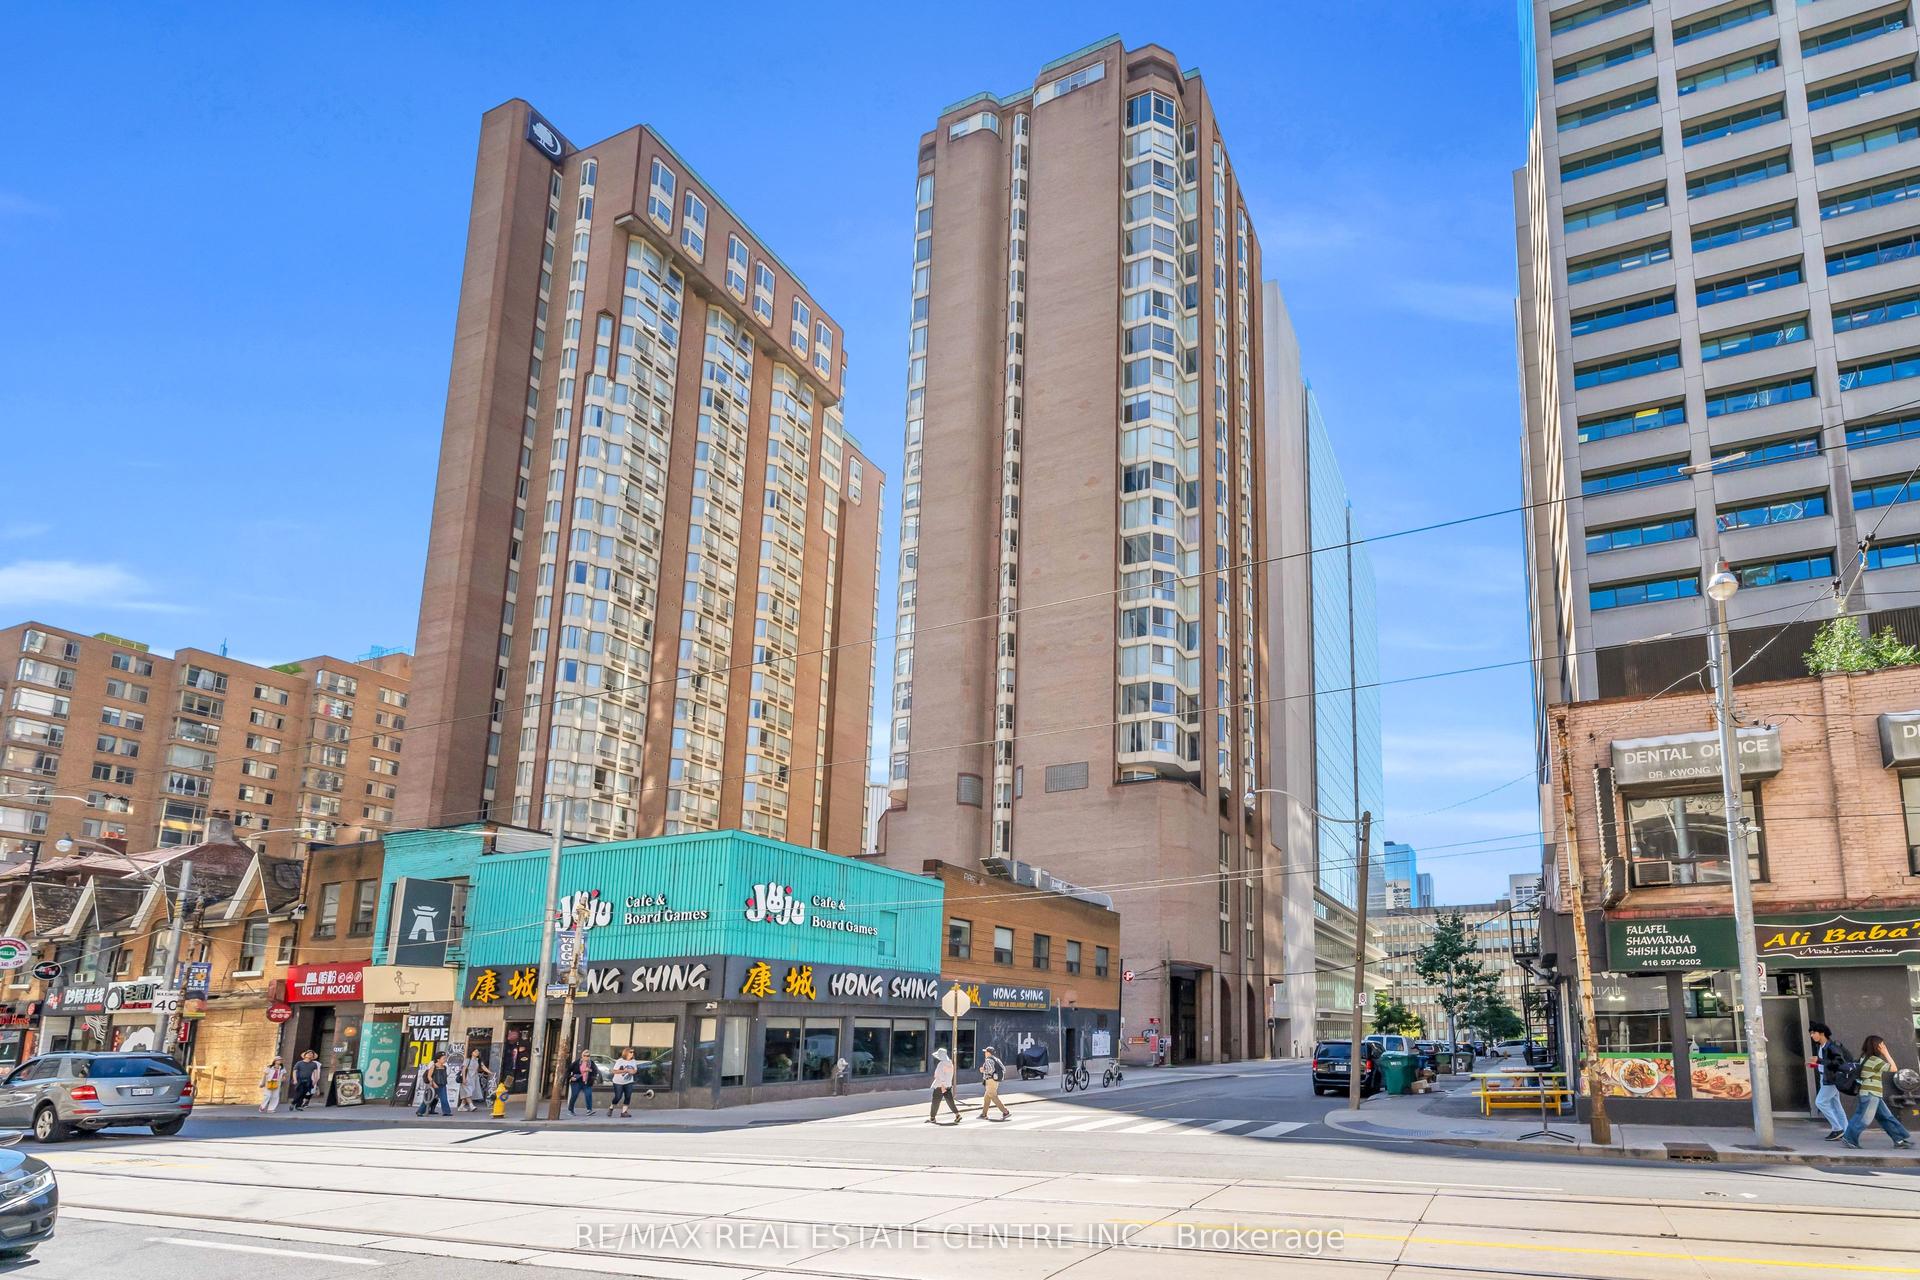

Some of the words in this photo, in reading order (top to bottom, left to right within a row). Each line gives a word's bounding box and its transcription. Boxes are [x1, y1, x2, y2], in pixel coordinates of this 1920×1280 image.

[1903, 724, 1920, 738] D
[1624, 747, 1692, 765] DENTAL
[1700, 739, 1769, 758] OFICE
[1648, 770, 1666, 779] DR.
[1669, 766, 1711, 777] KWONG
[625, 894, 652, 908] Cafe
[655, 892, 666, 905] &
[812, 895, 836, 909] Cafe
[838, 899, 847, 911] &
[624, 910, 661, 925] Board
[664, 909, 708, 922] Games
[812, 915, 844, 931] Board
[845, 921, 878, 936] Games
[1626, 925, 1668, 935] FALAFEL
[1626, 935, 1691, 946] SHAWARMA
[1763, 930, 1813, 948] Ali
[1822, 921, 1920, 943] Baba'
[1626, 946, 1659, 956] SHISH
[1661, 945, 1697, 955] KABAB
[1642, 959, 1658, 967] 416
[1660, 958, 1702, 966] 597-0202
[631, 963, 708, 992] SHING
[326, 984, 356, 995] NOODLE
[830, 971, 884, 998] HONG
[890, 976, 938, 1000] SHING
[993, 987, 1017, 1000] HONG
[1020, 988, 1044, 1001] SHING
[155, 1000, 178, 1011] 40
[408, 1015, 445, 1027] SUPER
[413, 1027, 449, 1041] VAPE
